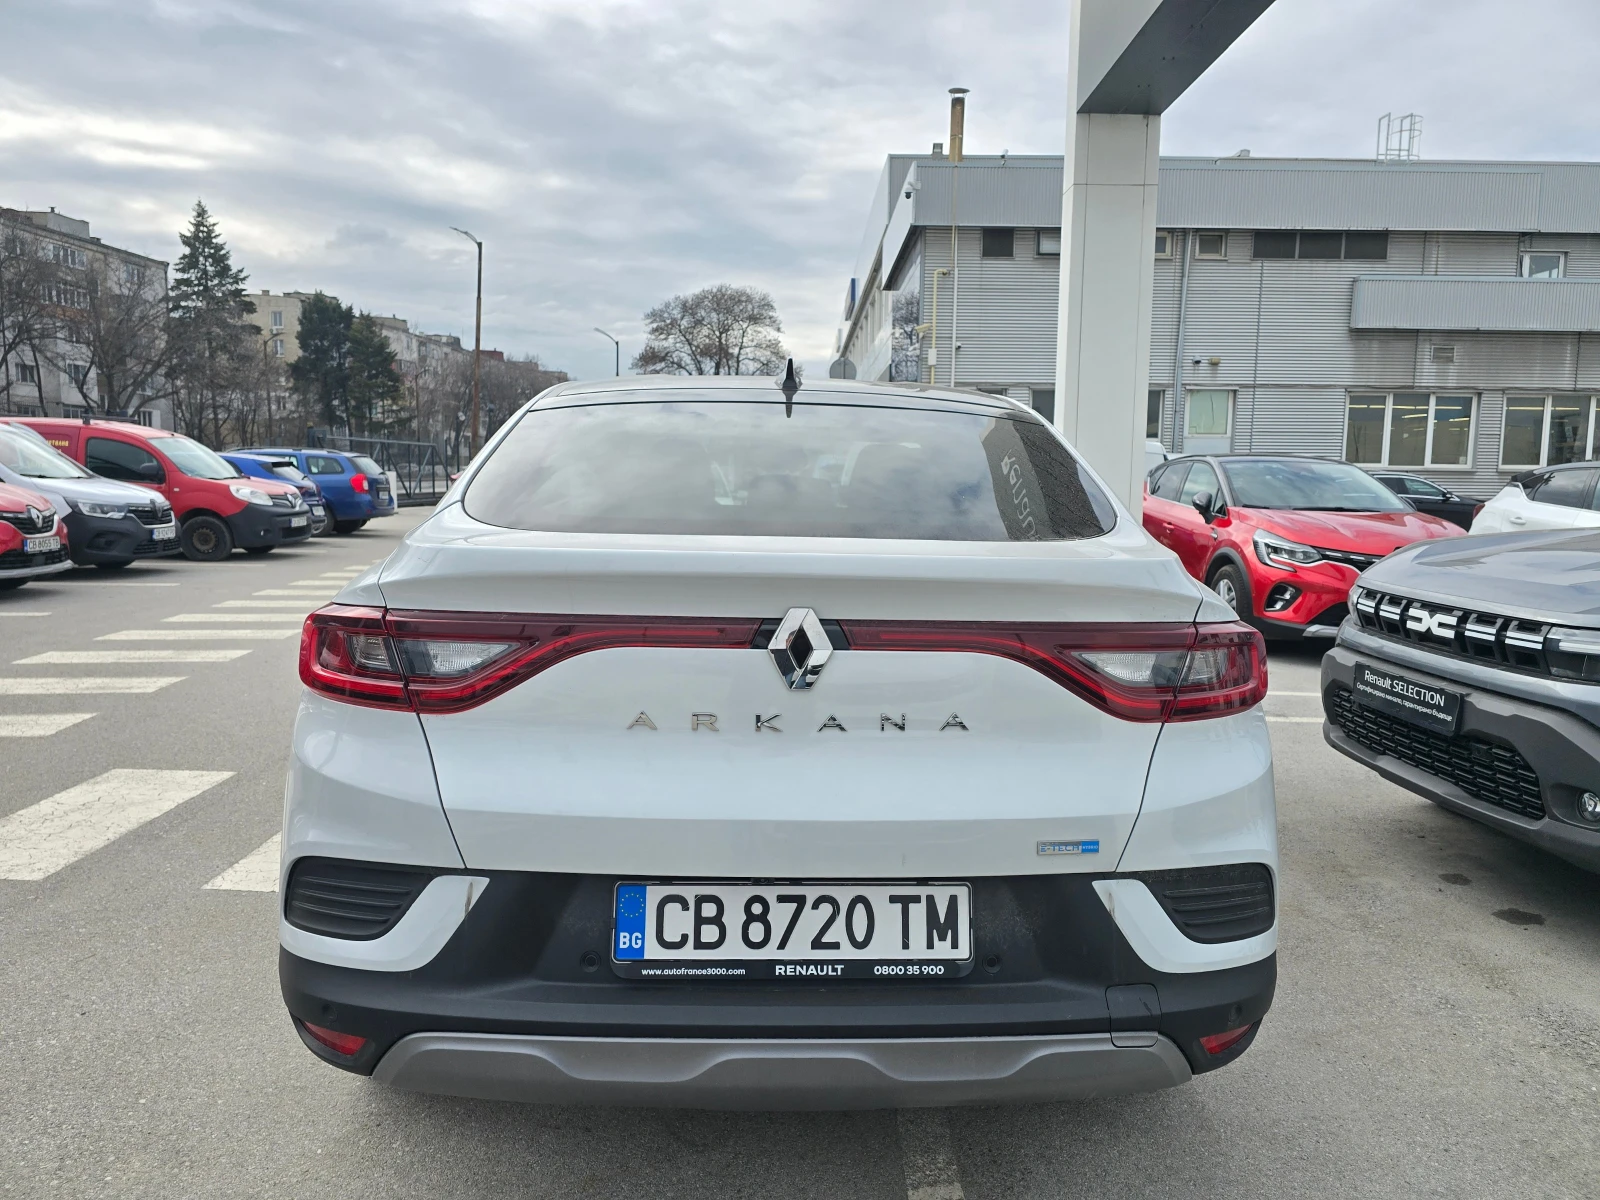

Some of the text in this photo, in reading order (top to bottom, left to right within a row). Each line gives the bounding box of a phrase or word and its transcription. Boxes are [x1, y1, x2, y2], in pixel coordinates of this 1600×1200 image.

[28, 540, 37, 550] CB
[1364, 670, 1445, 707] Renault SELECTION
[626, 710, 970, 733] ARKANA
[1040, 843, 1080, 853] E-TECH
[655, 893, 959, 951] CB 8720 TM
[619, 931, 643, 949] BG
[641, 967, 746, 977] www.autofrance3000.com
[775, 965, 845, 976] RENAULT
[873, 965, 945, 976] 0800 35 900
